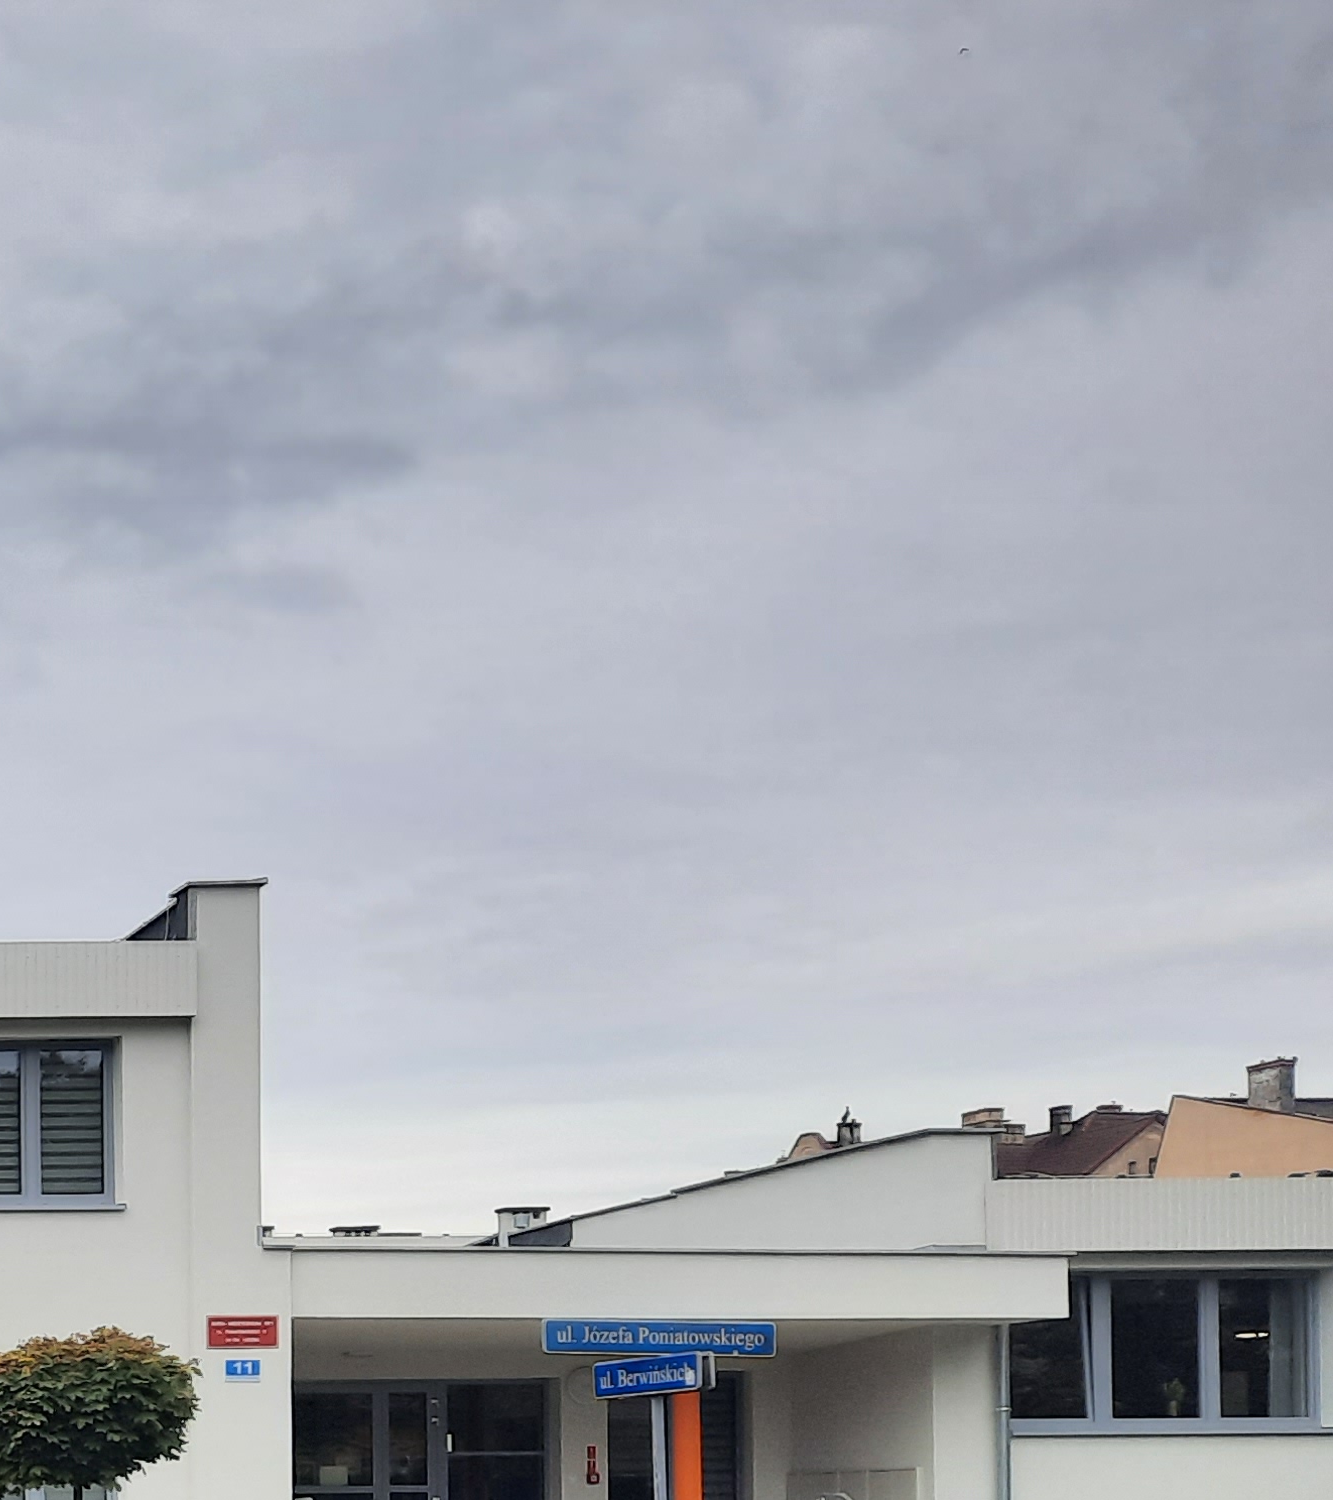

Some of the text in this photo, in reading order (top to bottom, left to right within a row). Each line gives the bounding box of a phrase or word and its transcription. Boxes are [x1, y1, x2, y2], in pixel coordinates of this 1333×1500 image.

[557, 1325, 765, 1350] ul. Józefa Poniatowskiego
[233, 1361, 253, 1375] 11
[599, 1370, 614, 1389] ul.
